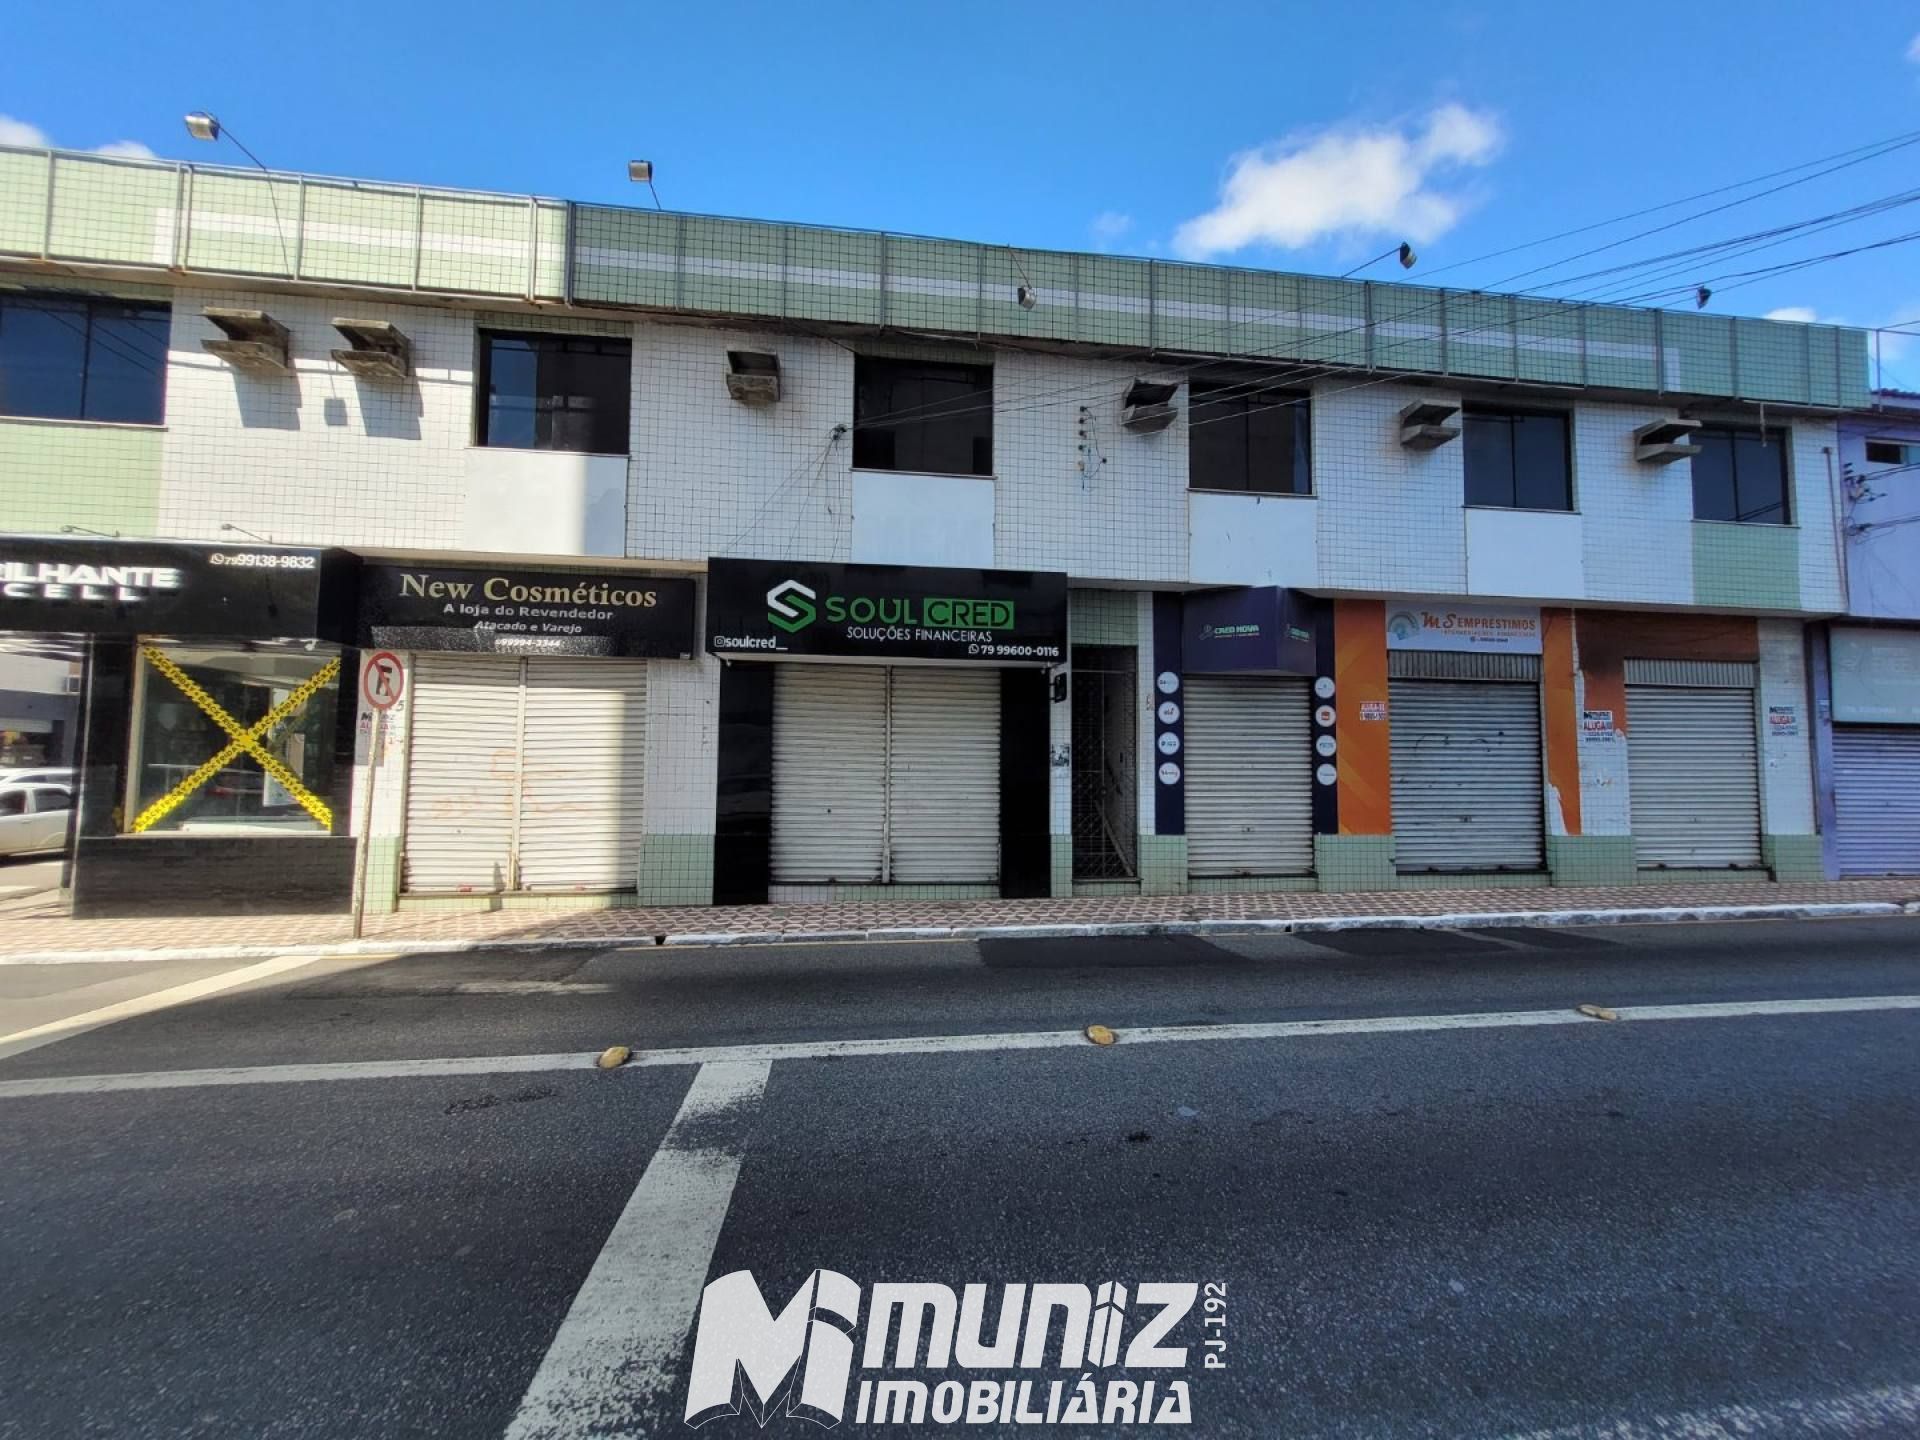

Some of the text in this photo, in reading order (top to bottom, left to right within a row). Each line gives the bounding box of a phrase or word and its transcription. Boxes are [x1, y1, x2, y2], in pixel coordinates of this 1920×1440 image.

[0, 562, 183, 589] ILHANTE
[3, 583, 144, 601] CELL
[400, 573, 658, 608] New Cosméticos
[443, 603, 614, 620] A loja do Revendedor
[825, 596, 1012, 628] SOUL CRED
[474, 620, 582, 634] Atacado e Varejo
[847, 625, 992, 642] SOLUÇÕES FINANCEIRAS
[980, 645, 1060, 657] 79 99600-0116
